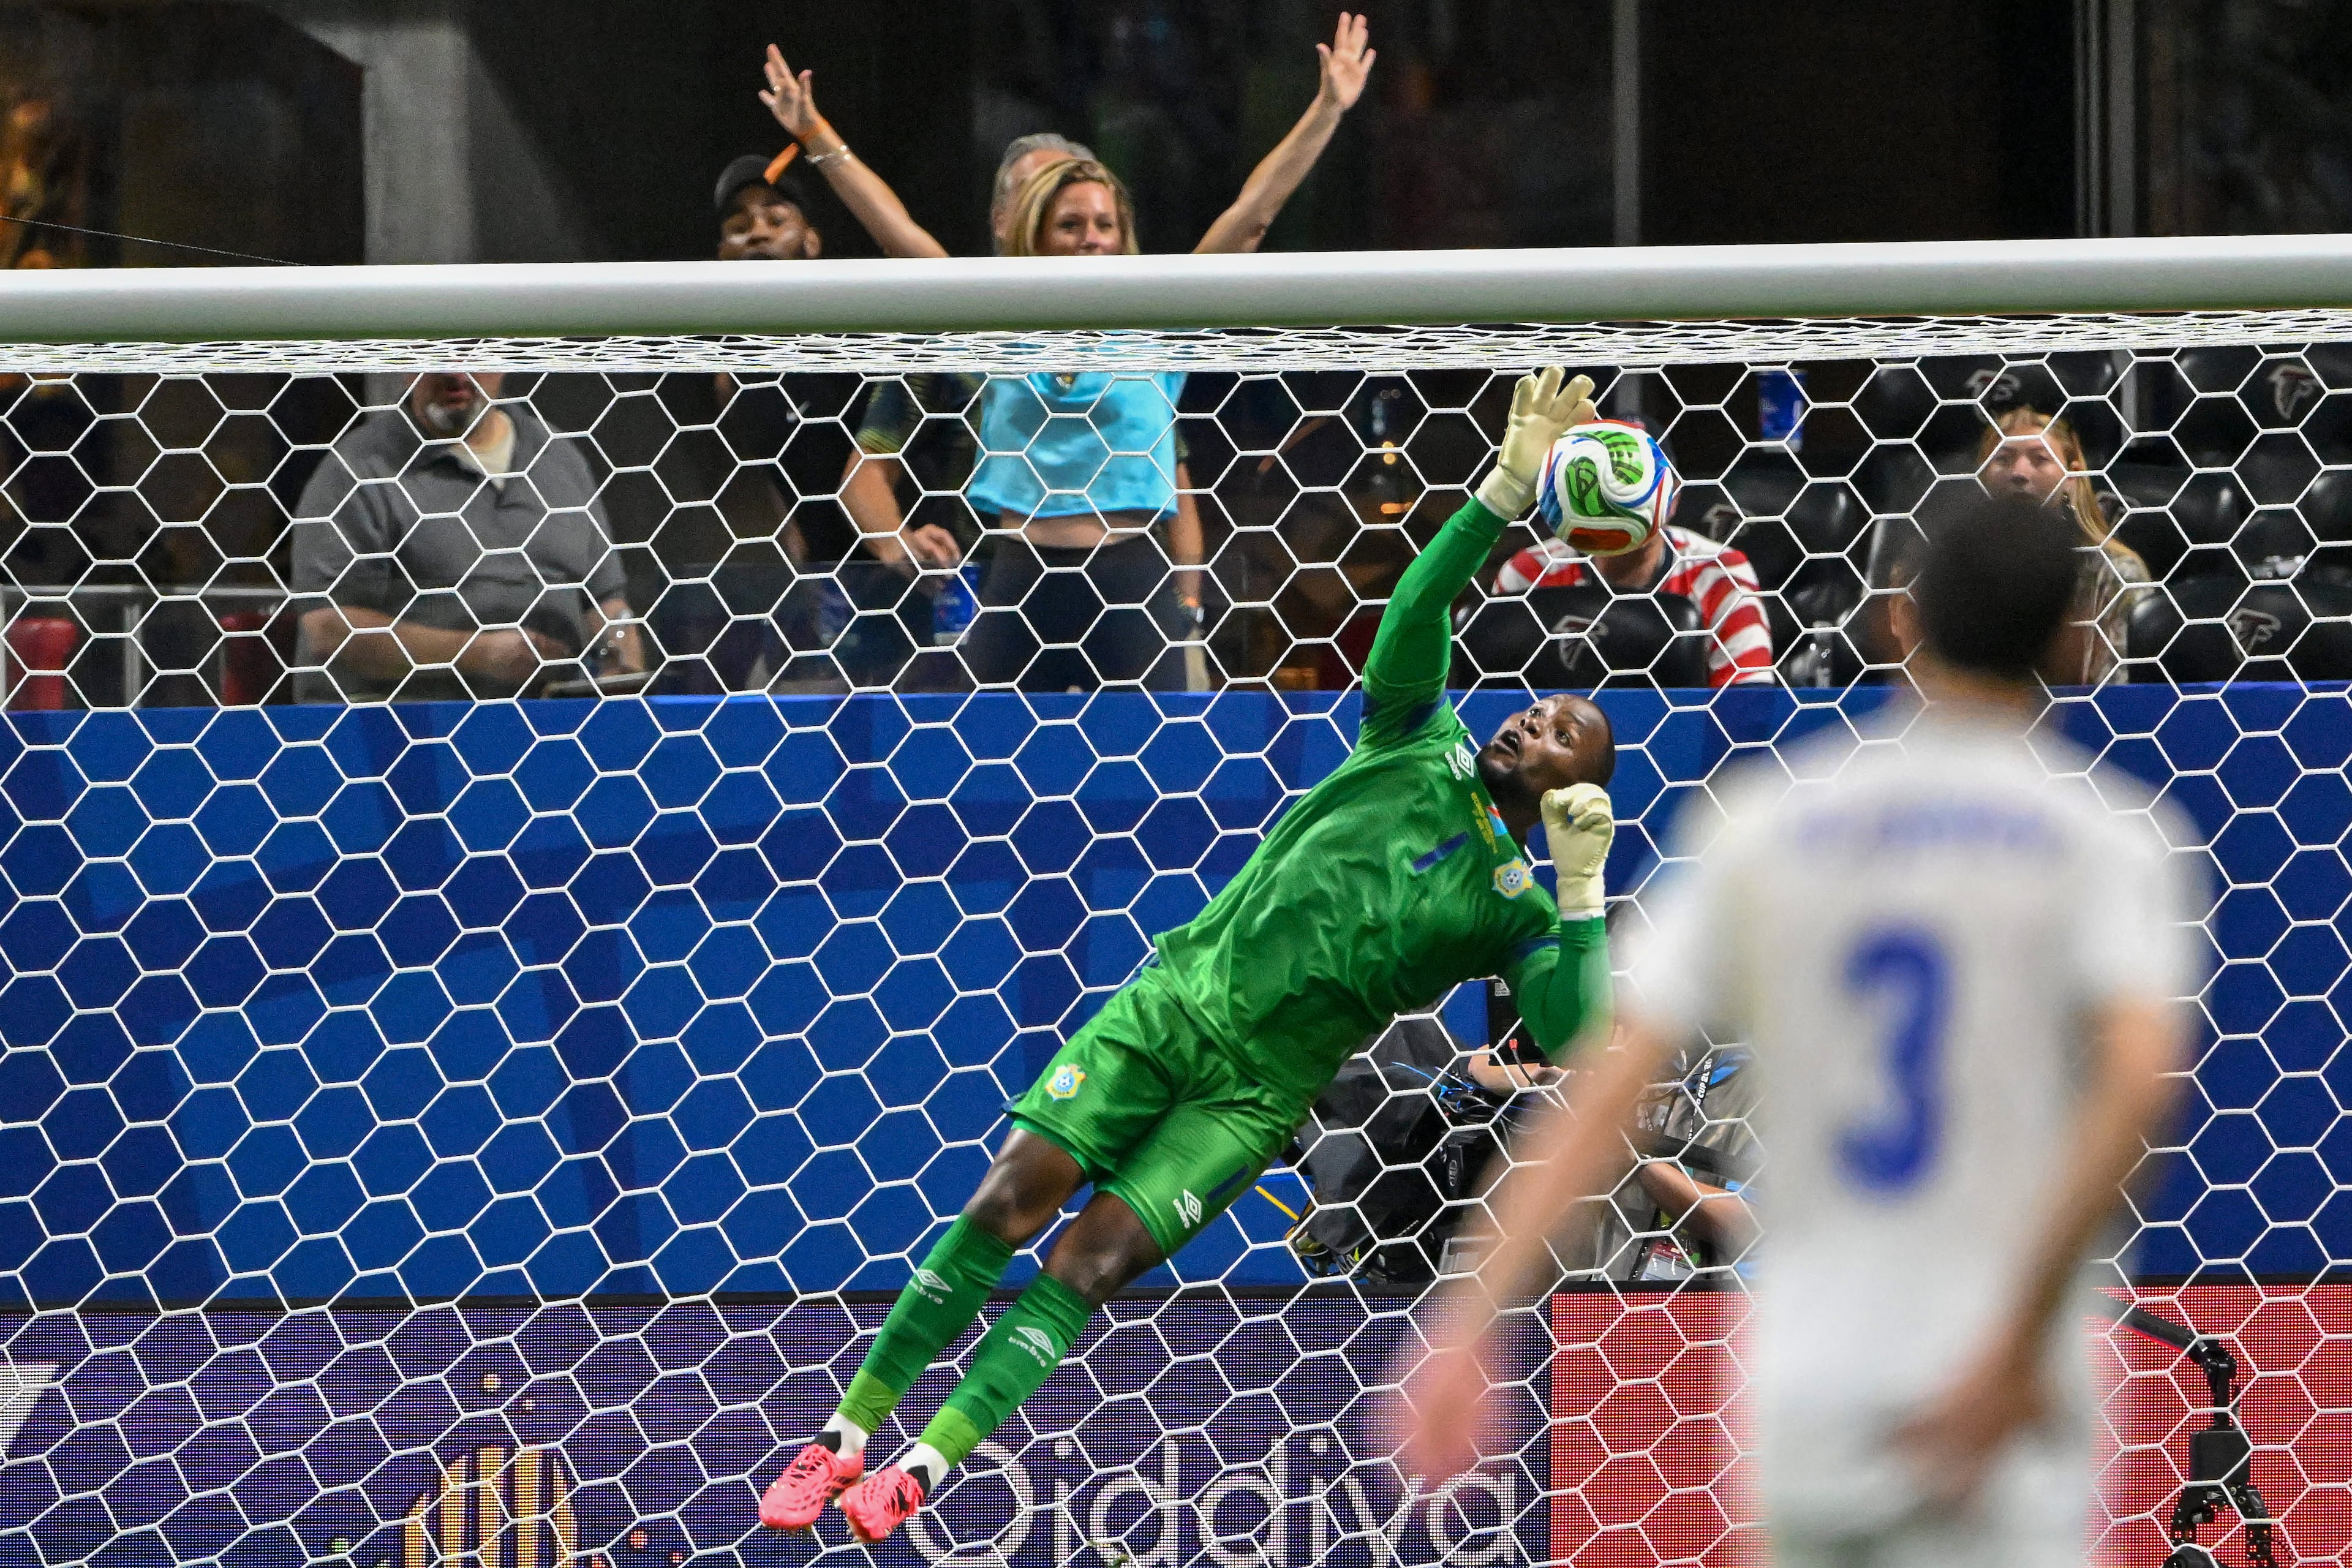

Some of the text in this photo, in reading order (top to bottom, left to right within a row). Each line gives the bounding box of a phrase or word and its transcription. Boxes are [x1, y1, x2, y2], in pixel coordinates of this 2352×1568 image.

[1836, 924, 1952, 1193] 3
[1697, 1082, 1706, 1099] CUP
[1008, 1336, 1046, 1367] umbro
